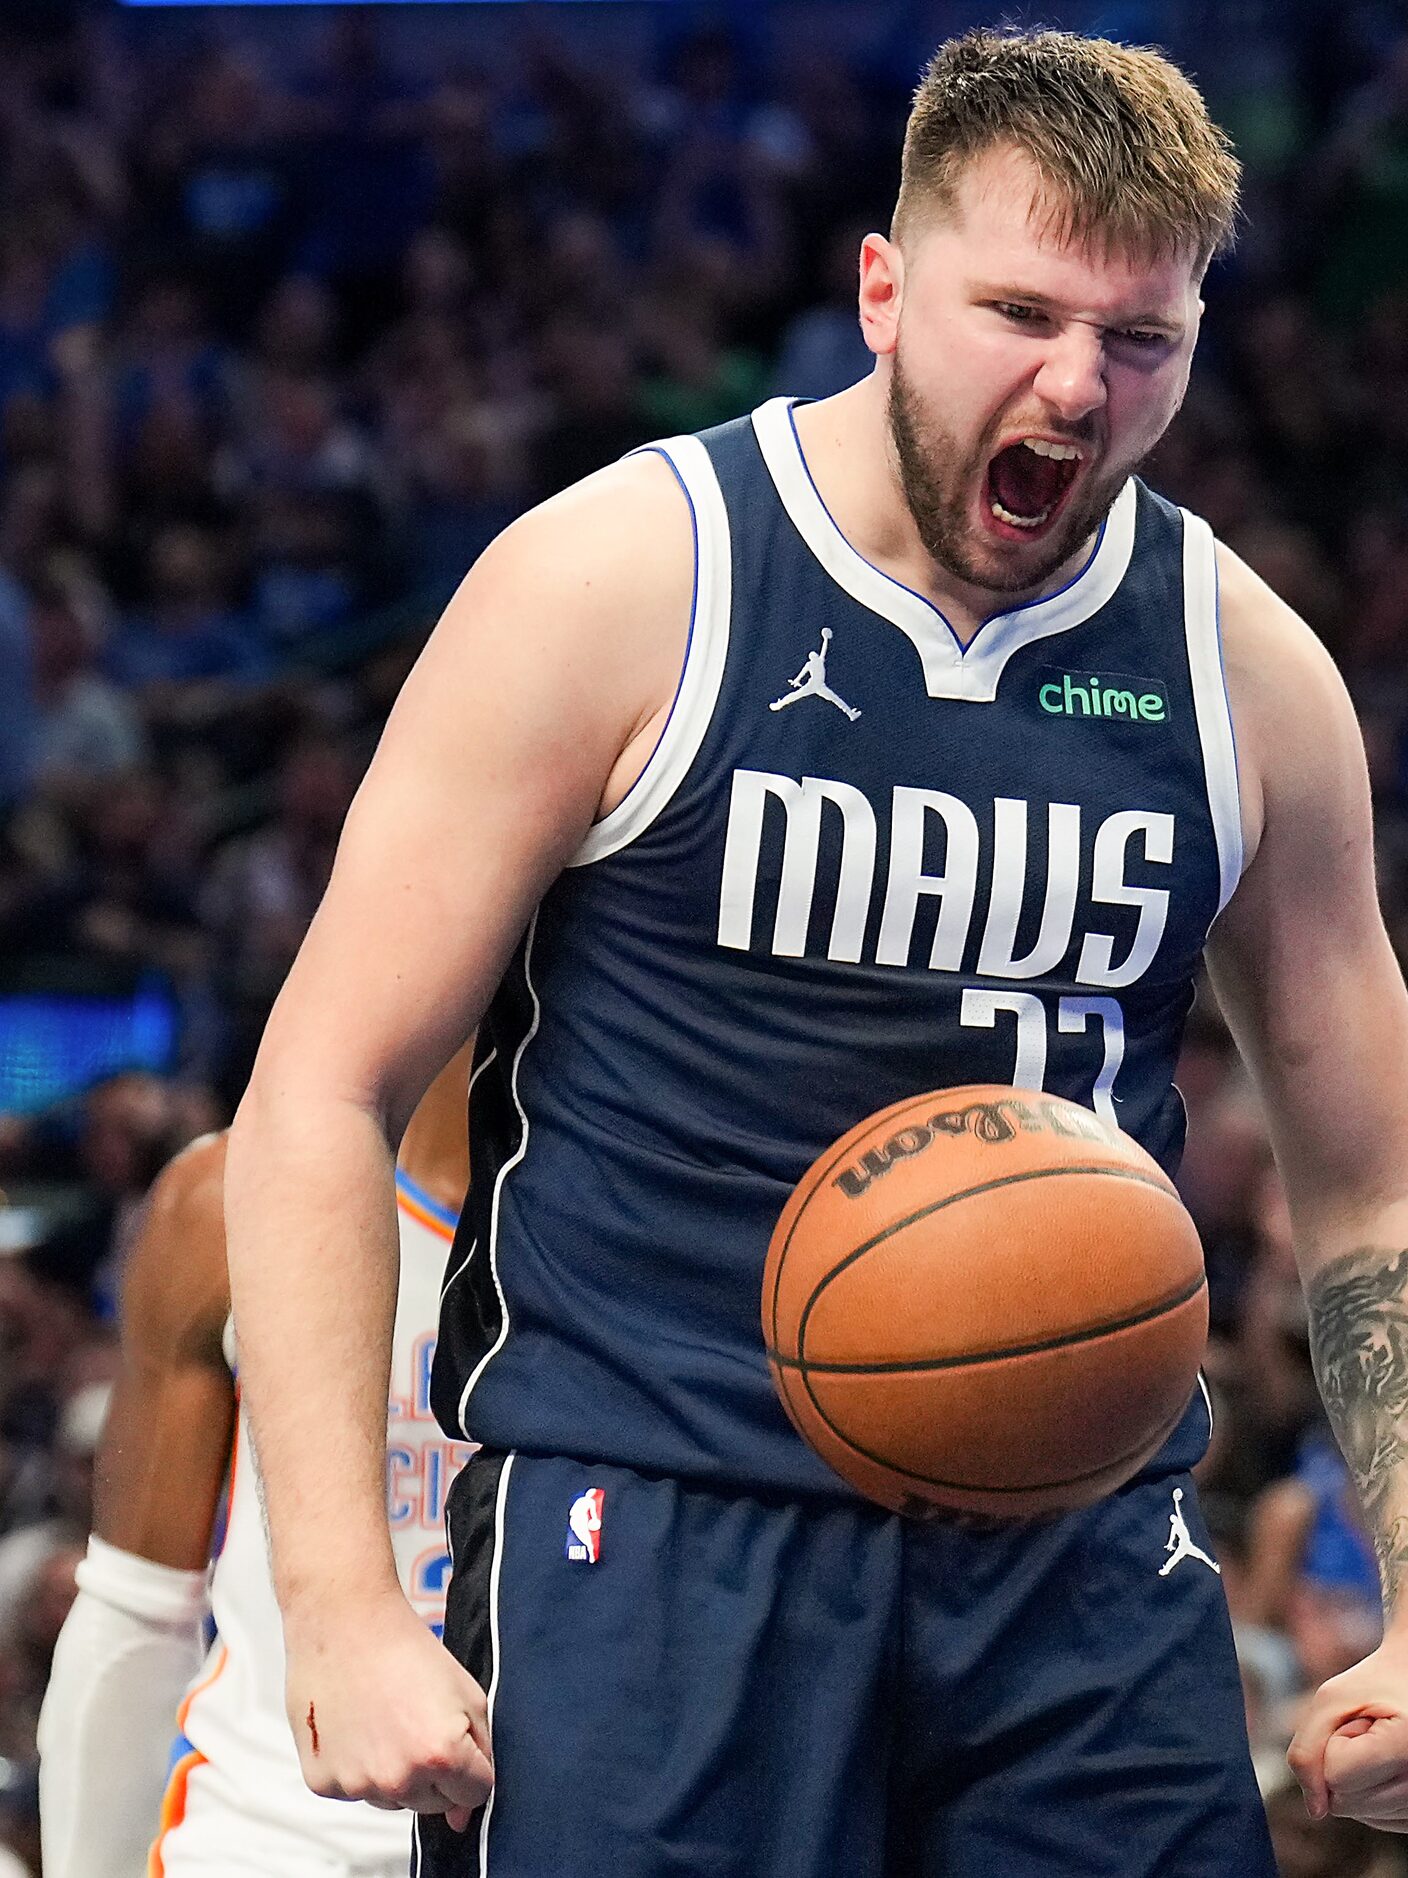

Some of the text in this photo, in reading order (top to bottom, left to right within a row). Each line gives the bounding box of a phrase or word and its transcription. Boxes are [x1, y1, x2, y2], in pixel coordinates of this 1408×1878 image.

[1039, 674, 1165, 721] chime
[716, 768, 1175, 988] MAVS
[568, 1545, 587, 1560] NBA
